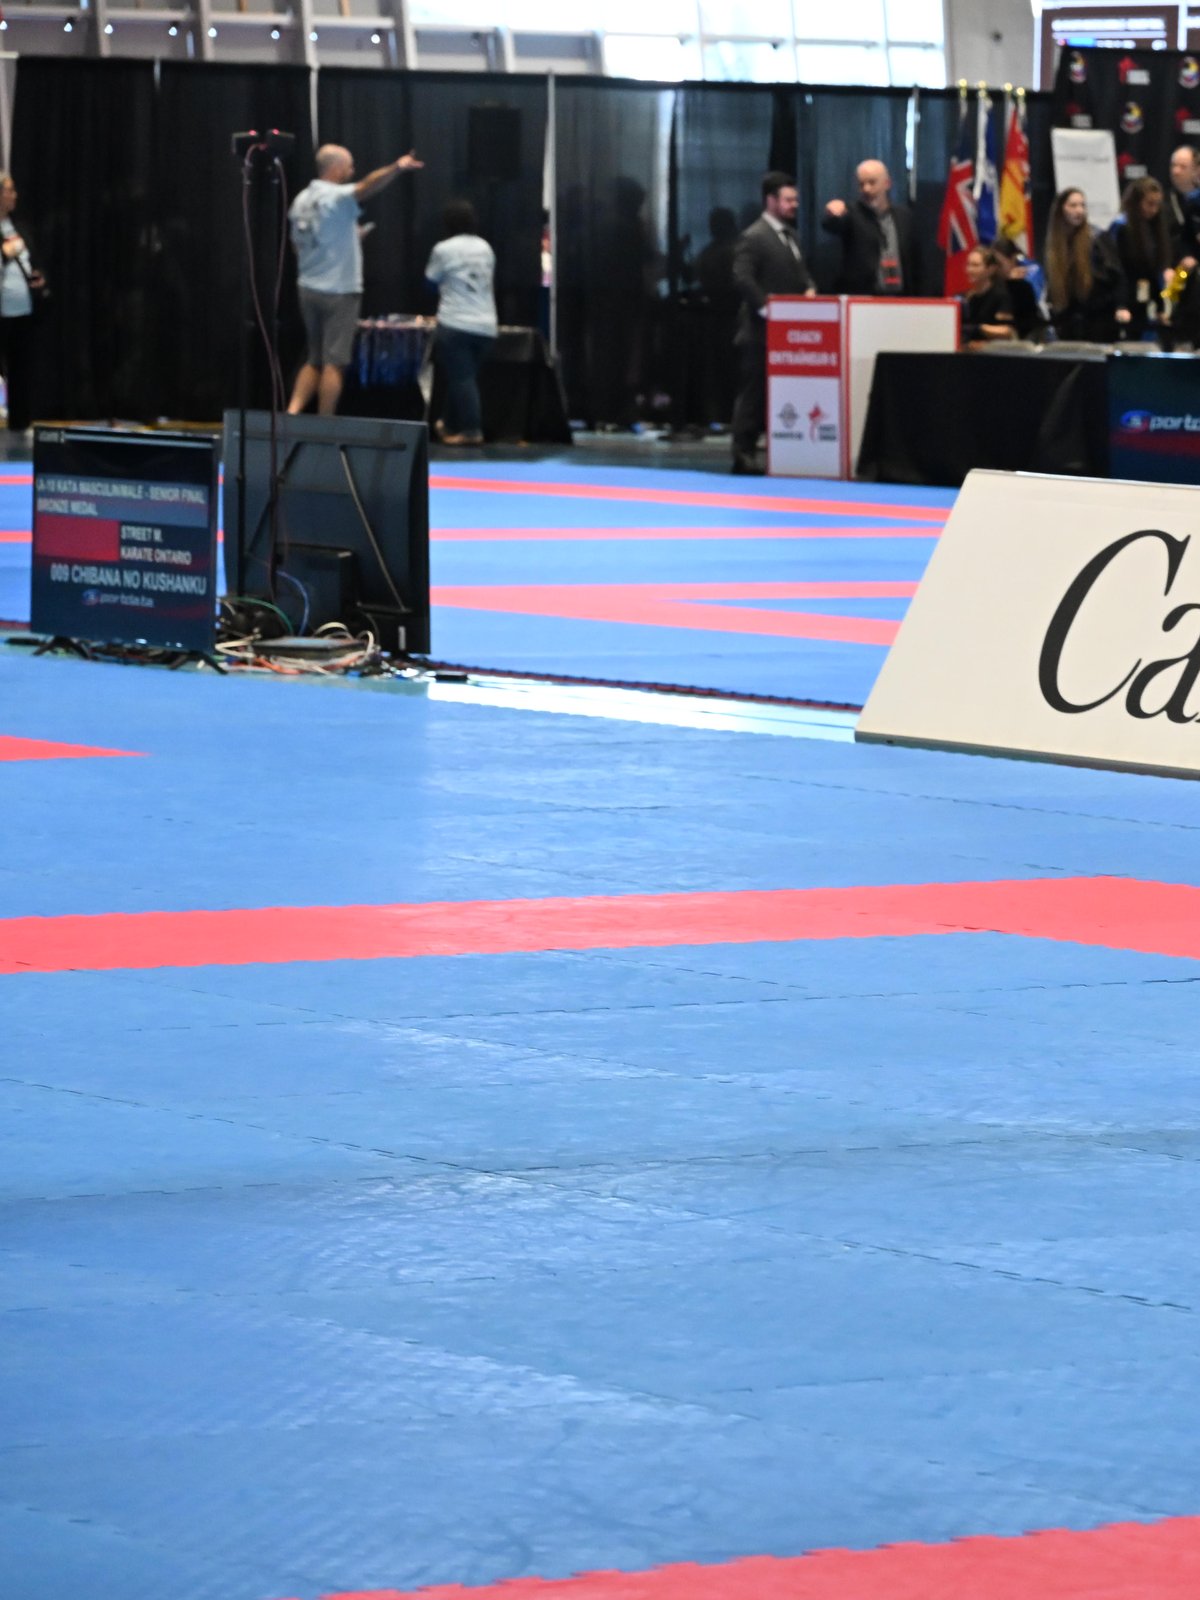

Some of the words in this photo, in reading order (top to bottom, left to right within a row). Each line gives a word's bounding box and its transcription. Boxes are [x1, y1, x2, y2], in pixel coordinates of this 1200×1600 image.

[121, 525, 152, 542] STREET
[120, 545, 153, 562] KARATE
[72, 564, 121, 586] CHIBANA
[123, 569, 141, 589] NO
[143, 571, 207, 595] KUSHANKU
